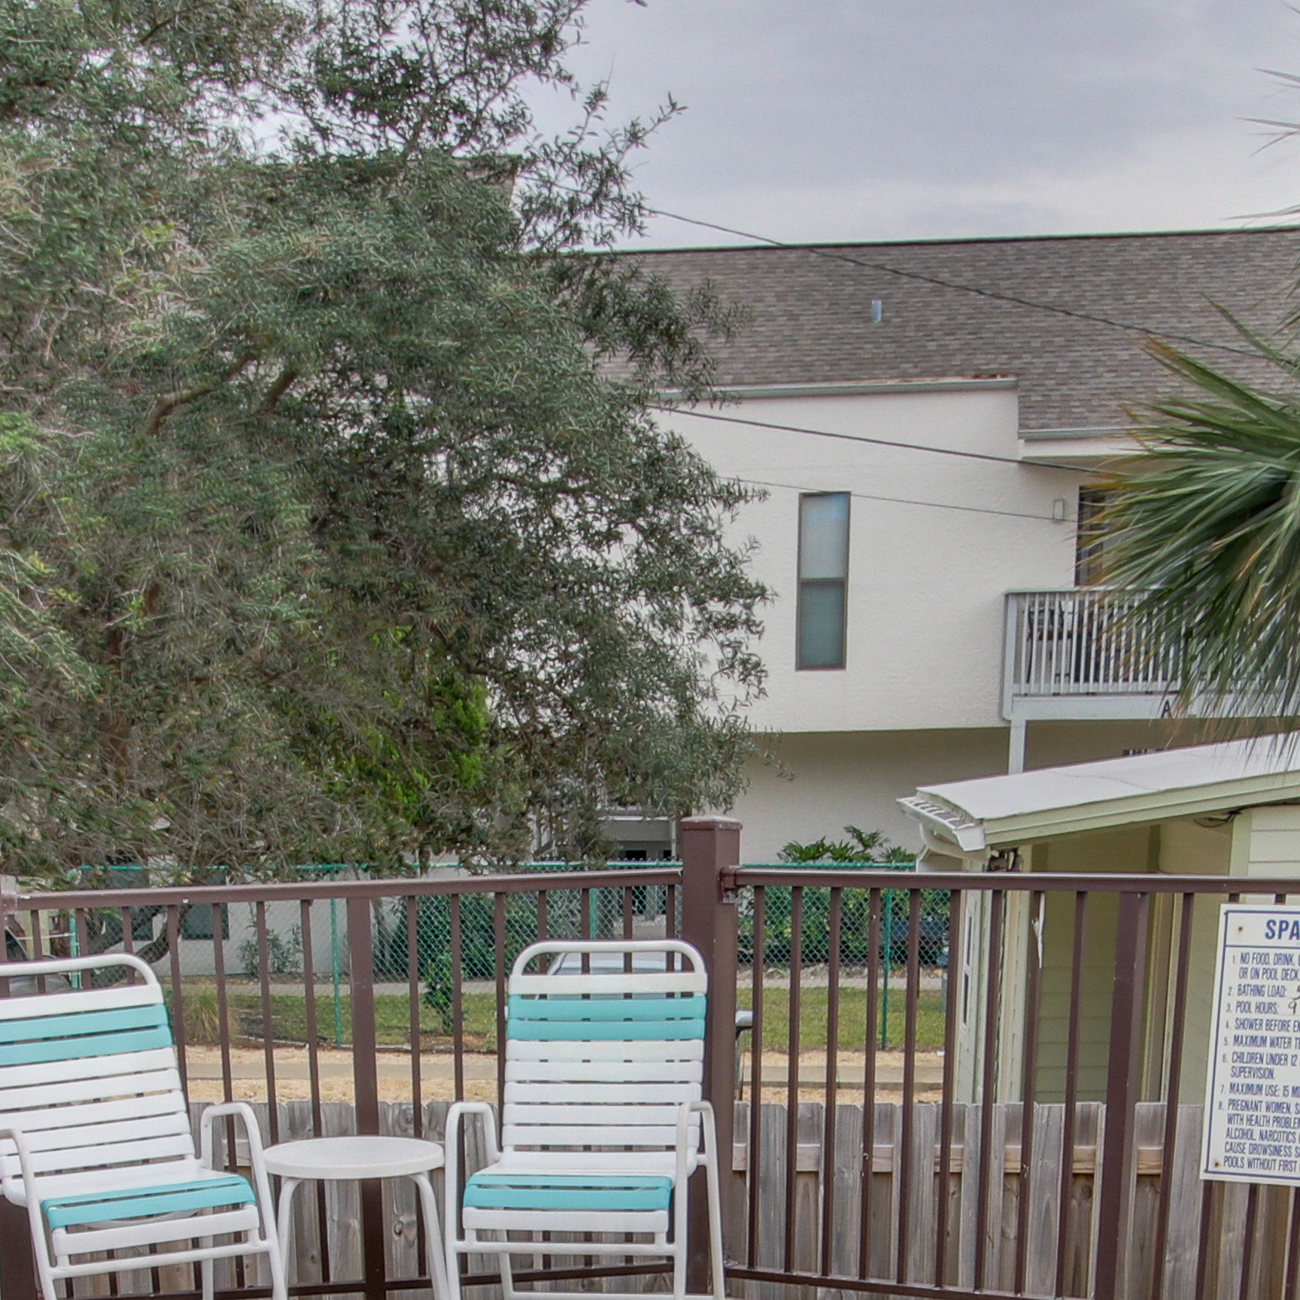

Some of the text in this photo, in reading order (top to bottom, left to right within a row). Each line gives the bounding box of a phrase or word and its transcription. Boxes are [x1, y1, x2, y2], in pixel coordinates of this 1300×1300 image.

[1265, 920, 1300, 940] SPA
[1240, 952, 1250, 964] NO
[1239, 967, 1248, 979] OR
[1250, 968, 1260, 979] ON
[1262, 968, 1278, 980] POOL
[1237, 984, 1265, 996] BATHING
[1236, 1001, 1252, 1013] POOL
[1288, 1000, 1297, 1014] 9
[1235, 1018, 1263, 1030] SHOWER
[1265, 1019, 1291, 1031] BEFORE
[1233, 1035, 1267, 1047] MAXIMUM
[1270, 1037, 1291, 1049] WATER
[1232, 1052, 1264, 1064] CHILDREN
[1266, 1053, 1288, 1065] UNDER
[1291, 1055, 1298, 1066] 12
[1229, 1083, 1263, 1095] MAXIMUM
[1283, 1085, 1289, 1097] 15
[1228, 1099, 1263, 1112] PREGNANT
[1228, 1114, 1243, 1125] WITH
[1246, 1114, 1270, 1127] HEALTH
[1259, 1130, 1296, 1143] NARCOTICS
[1225, 1142, 1246, 1154] CAUSE
[1249, 1143, 1292, 1157] DROWSINESS
[1224, 1156, 1245, 1168] POOLS
[1247, 1158, 1276, 1170] WITHOUT
[1279, 1159, 1297, 1172] FIRST
